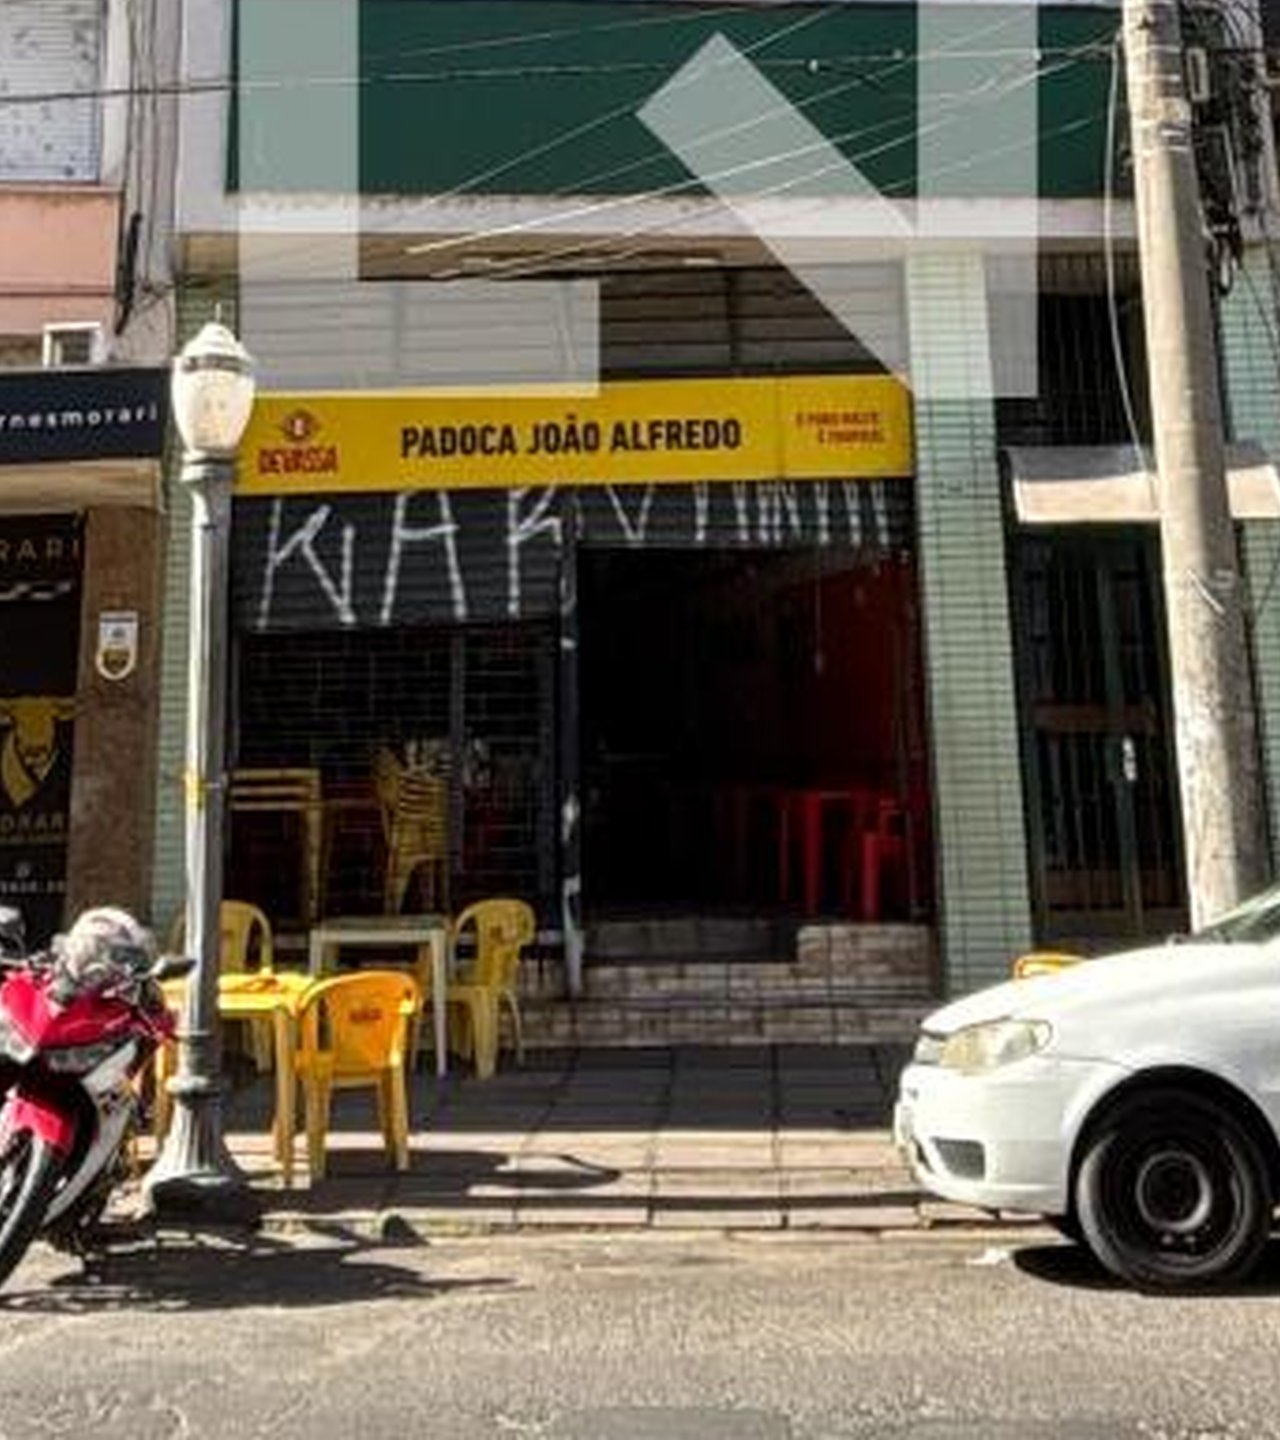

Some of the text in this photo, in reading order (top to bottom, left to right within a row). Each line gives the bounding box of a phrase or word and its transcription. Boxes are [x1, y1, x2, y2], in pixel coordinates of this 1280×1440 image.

[401, 412, 742, 459] PADOCA JOÃO ALFREDO
